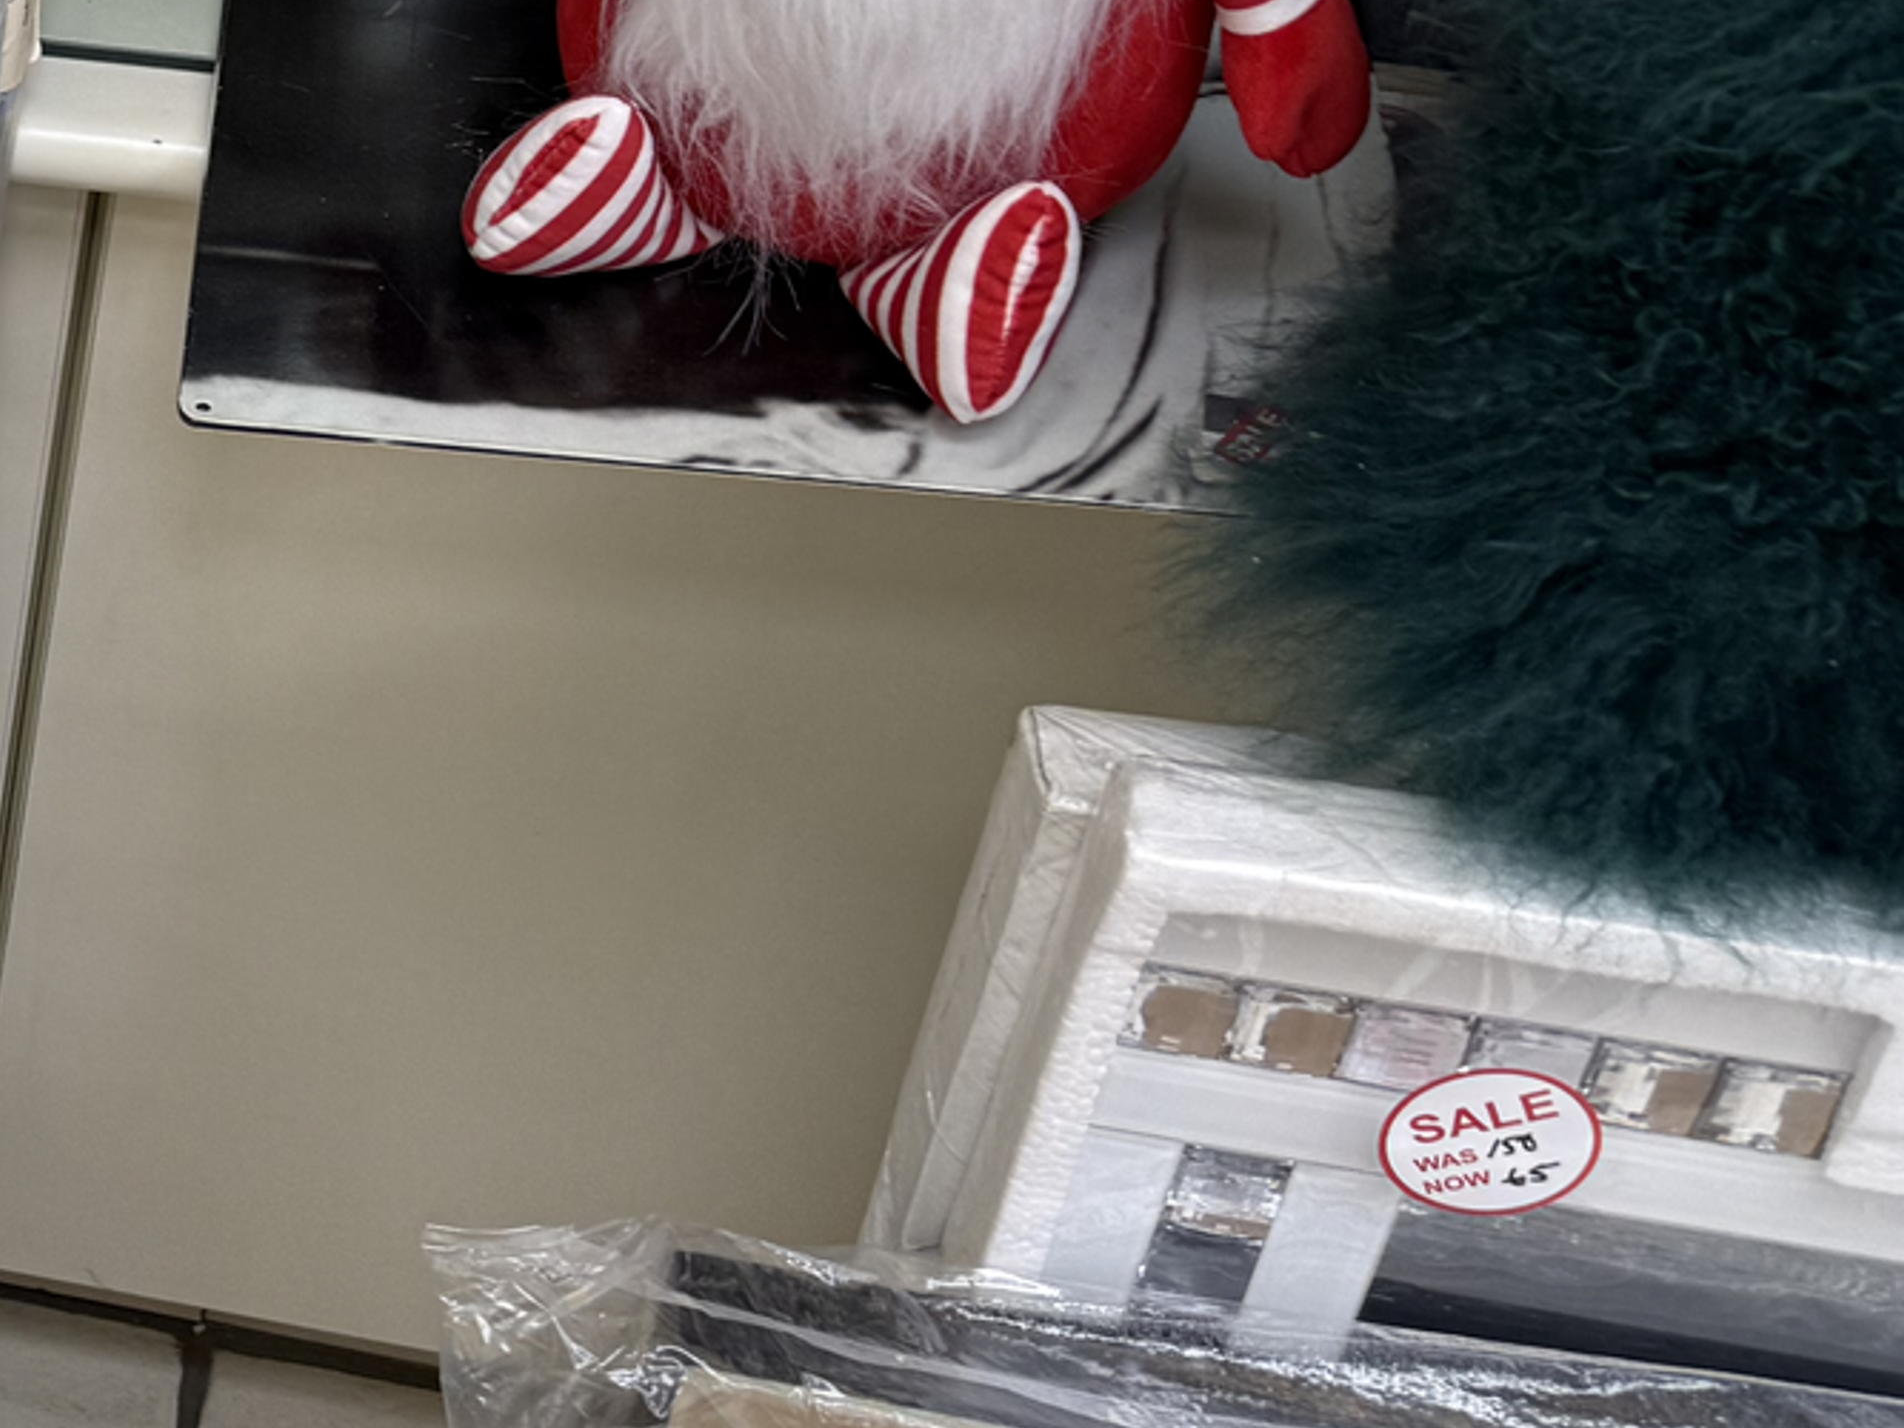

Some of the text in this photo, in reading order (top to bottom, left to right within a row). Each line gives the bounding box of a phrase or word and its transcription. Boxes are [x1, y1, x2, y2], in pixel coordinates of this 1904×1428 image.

[1409, 1089, 1560, 1144] SALE
[1413, 1148, 1479, 1174] WAS
[1423, 1170, 1491, 1195] NOW
